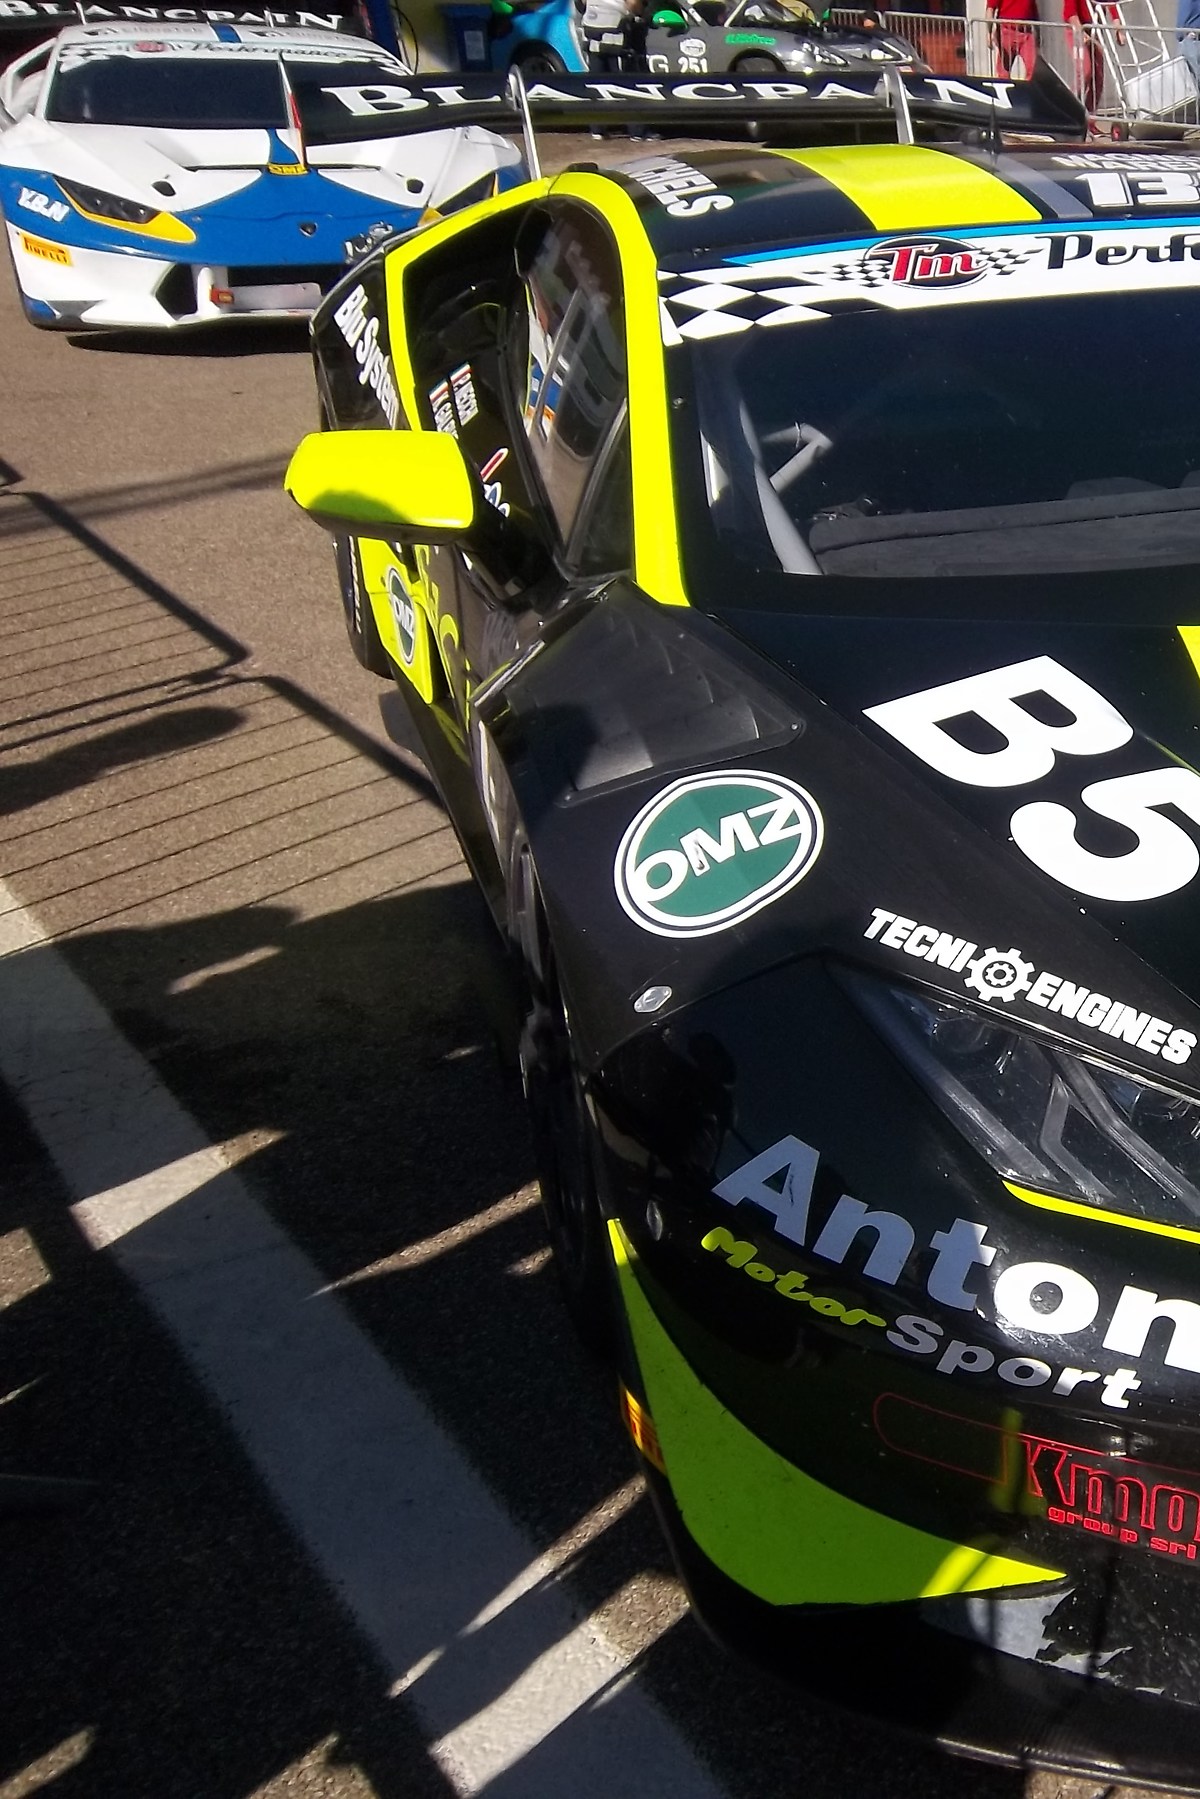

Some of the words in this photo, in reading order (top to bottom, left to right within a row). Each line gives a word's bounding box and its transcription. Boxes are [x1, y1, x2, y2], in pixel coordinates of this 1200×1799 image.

[678, 56, 709, 73] 251
[634, 800, 803, 903] OMZ
[862, 906, 978, 974] TECNI
[1025, 971, 1198, 1066] ENGINES
[1047, 1506, 1139, 1544] group
[1149, 1536, 1197, 1561] srl
